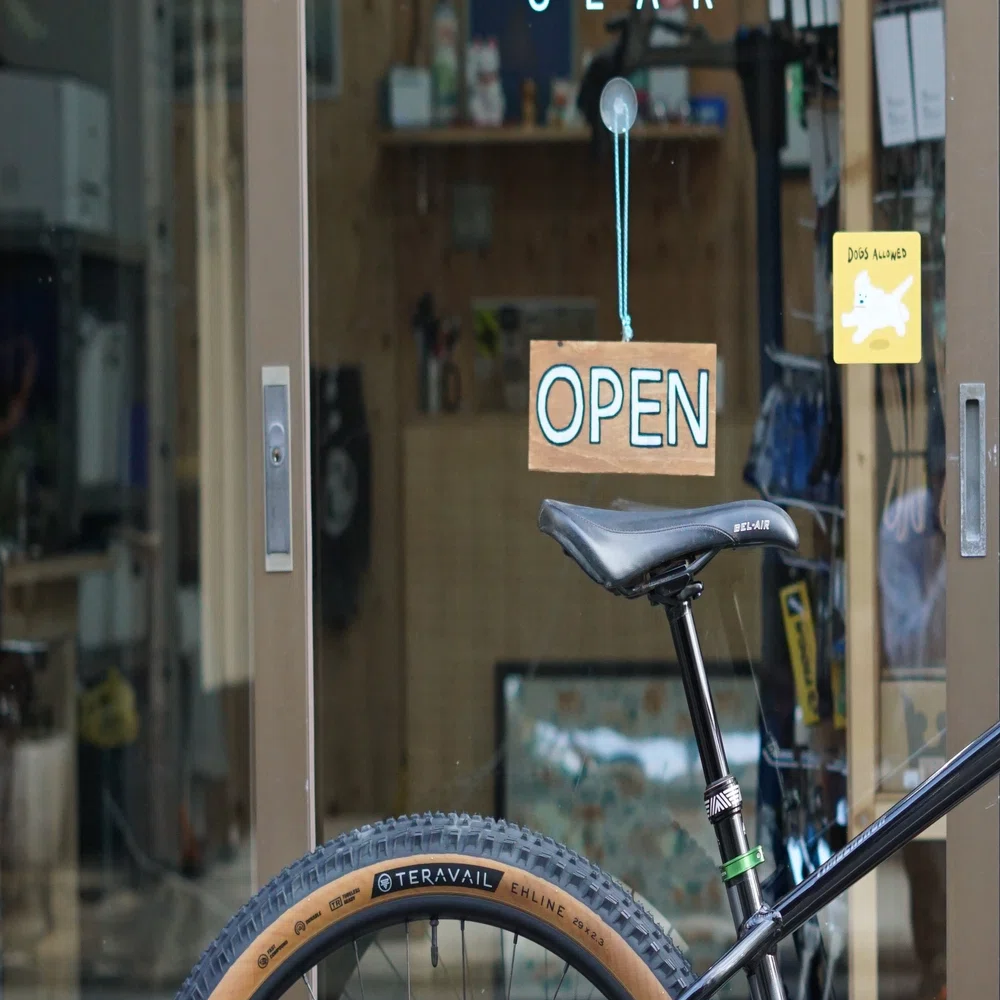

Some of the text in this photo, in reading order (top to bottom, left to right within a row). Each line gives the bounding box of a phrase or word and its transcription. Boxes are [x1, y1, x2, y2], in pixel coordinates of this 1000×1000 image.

[848, 247, 907, 263] DOGS ALLOWED
[536, 363, 710, 448] OPEN
[395, 867, 493, 888] TERAVAIL
[510, 882, 566, 918] EHLINE
